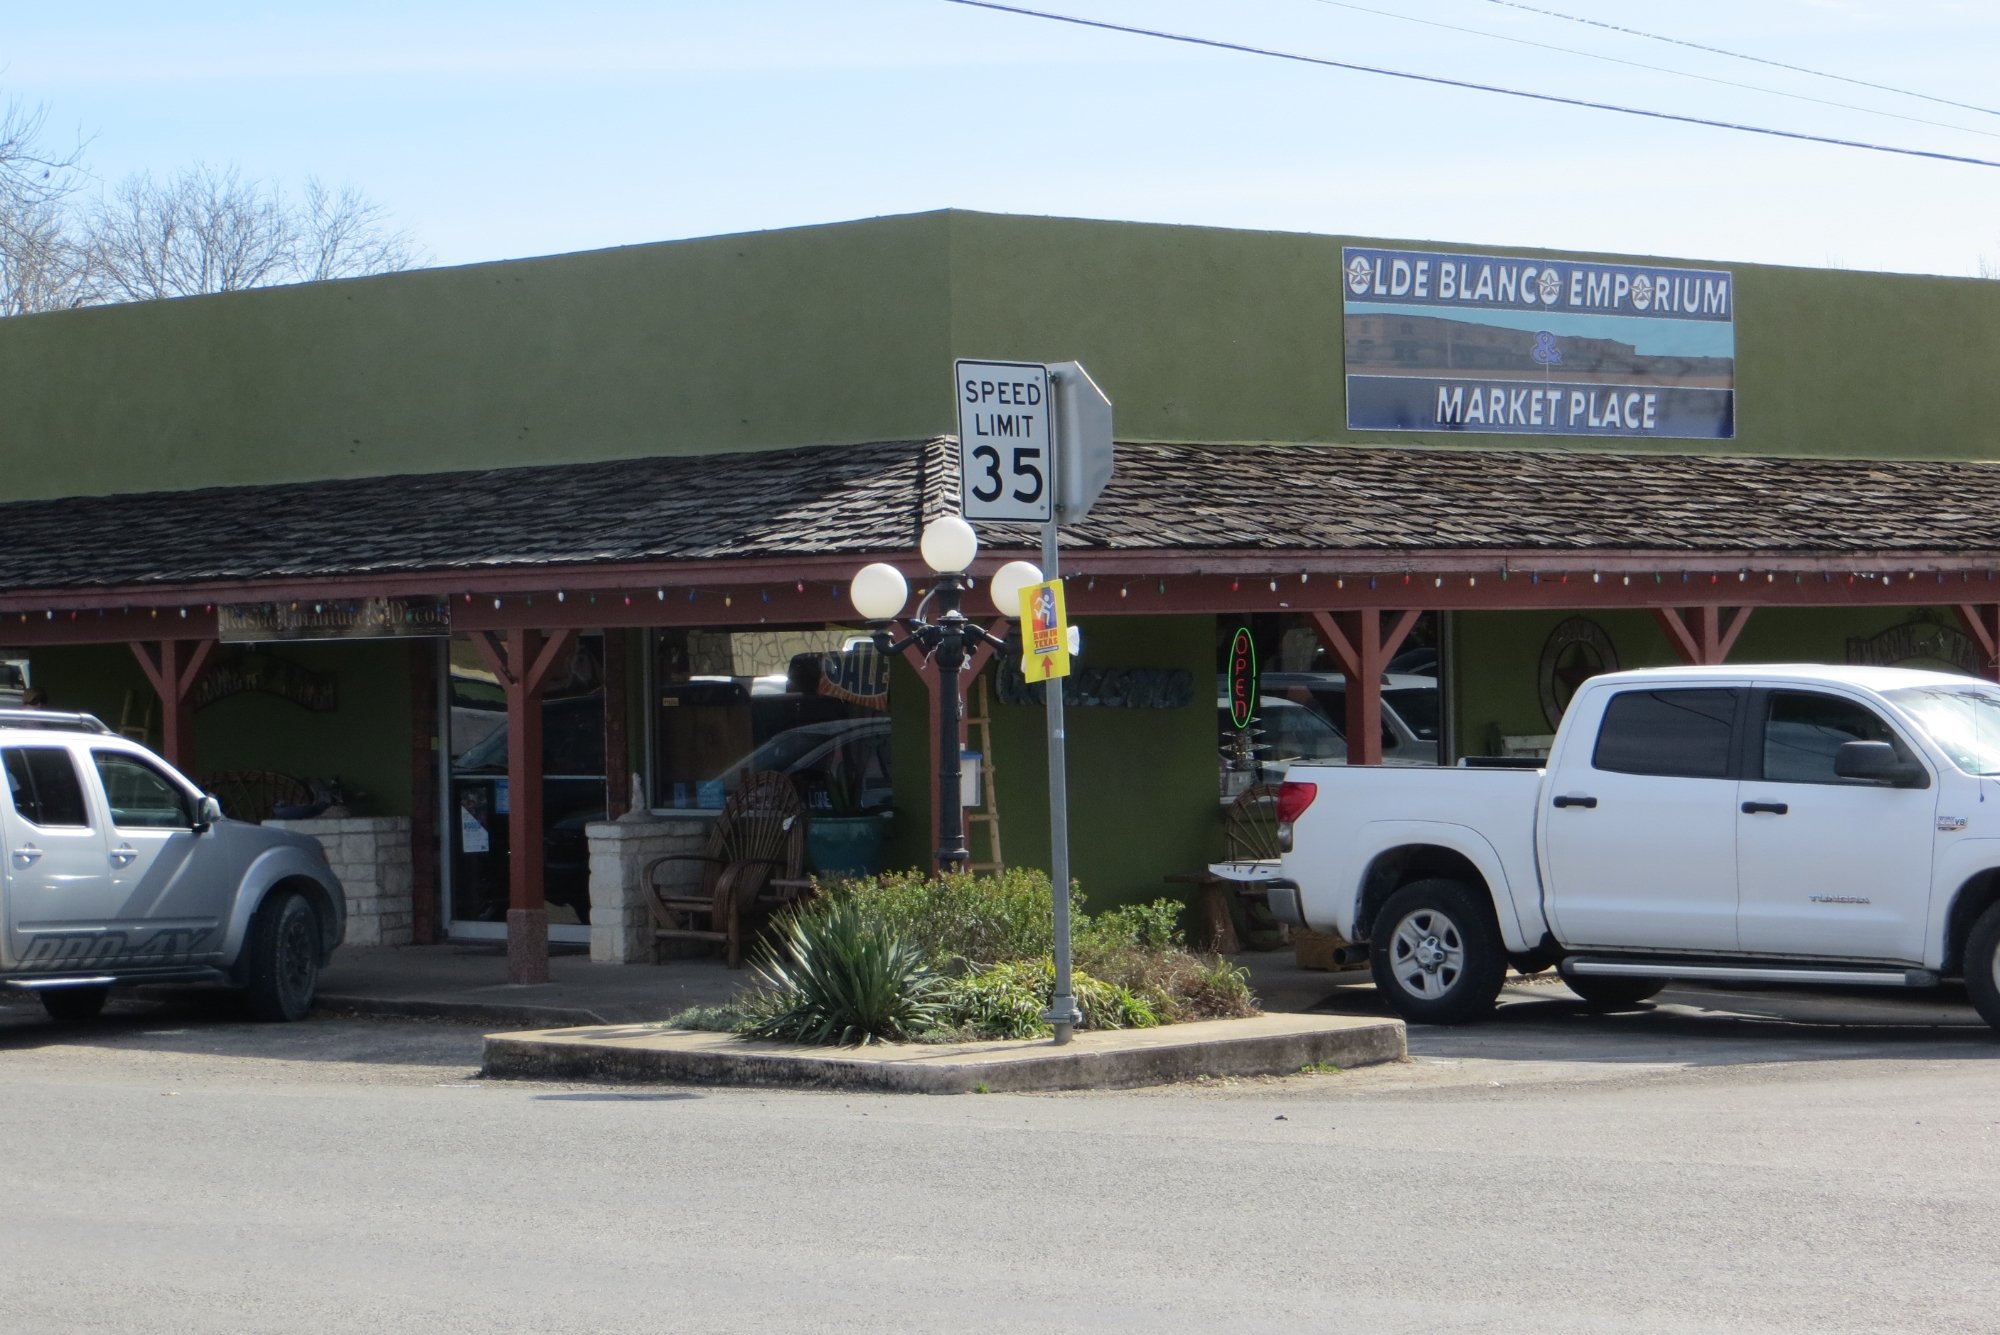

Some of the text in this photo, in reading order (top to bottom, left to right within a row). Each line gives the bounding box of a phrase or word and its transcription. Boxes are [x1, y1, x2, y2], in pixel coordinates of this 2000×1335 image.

[1348, 255, 1727, 314] OLDE BLANCO EMPORIUM
[1531, 330, 1562, 366] &
[965, 380, 1041, 406] SPEED
[1436, 386, 1657, 430] MARKET PLACE
[975, 413, 1034, 438] LIMIT
[972, 445, 1043, 504] 35
[1034, 638, 1058, 649] TEXAS
[1235, 634, 1249, 719] OPEN
